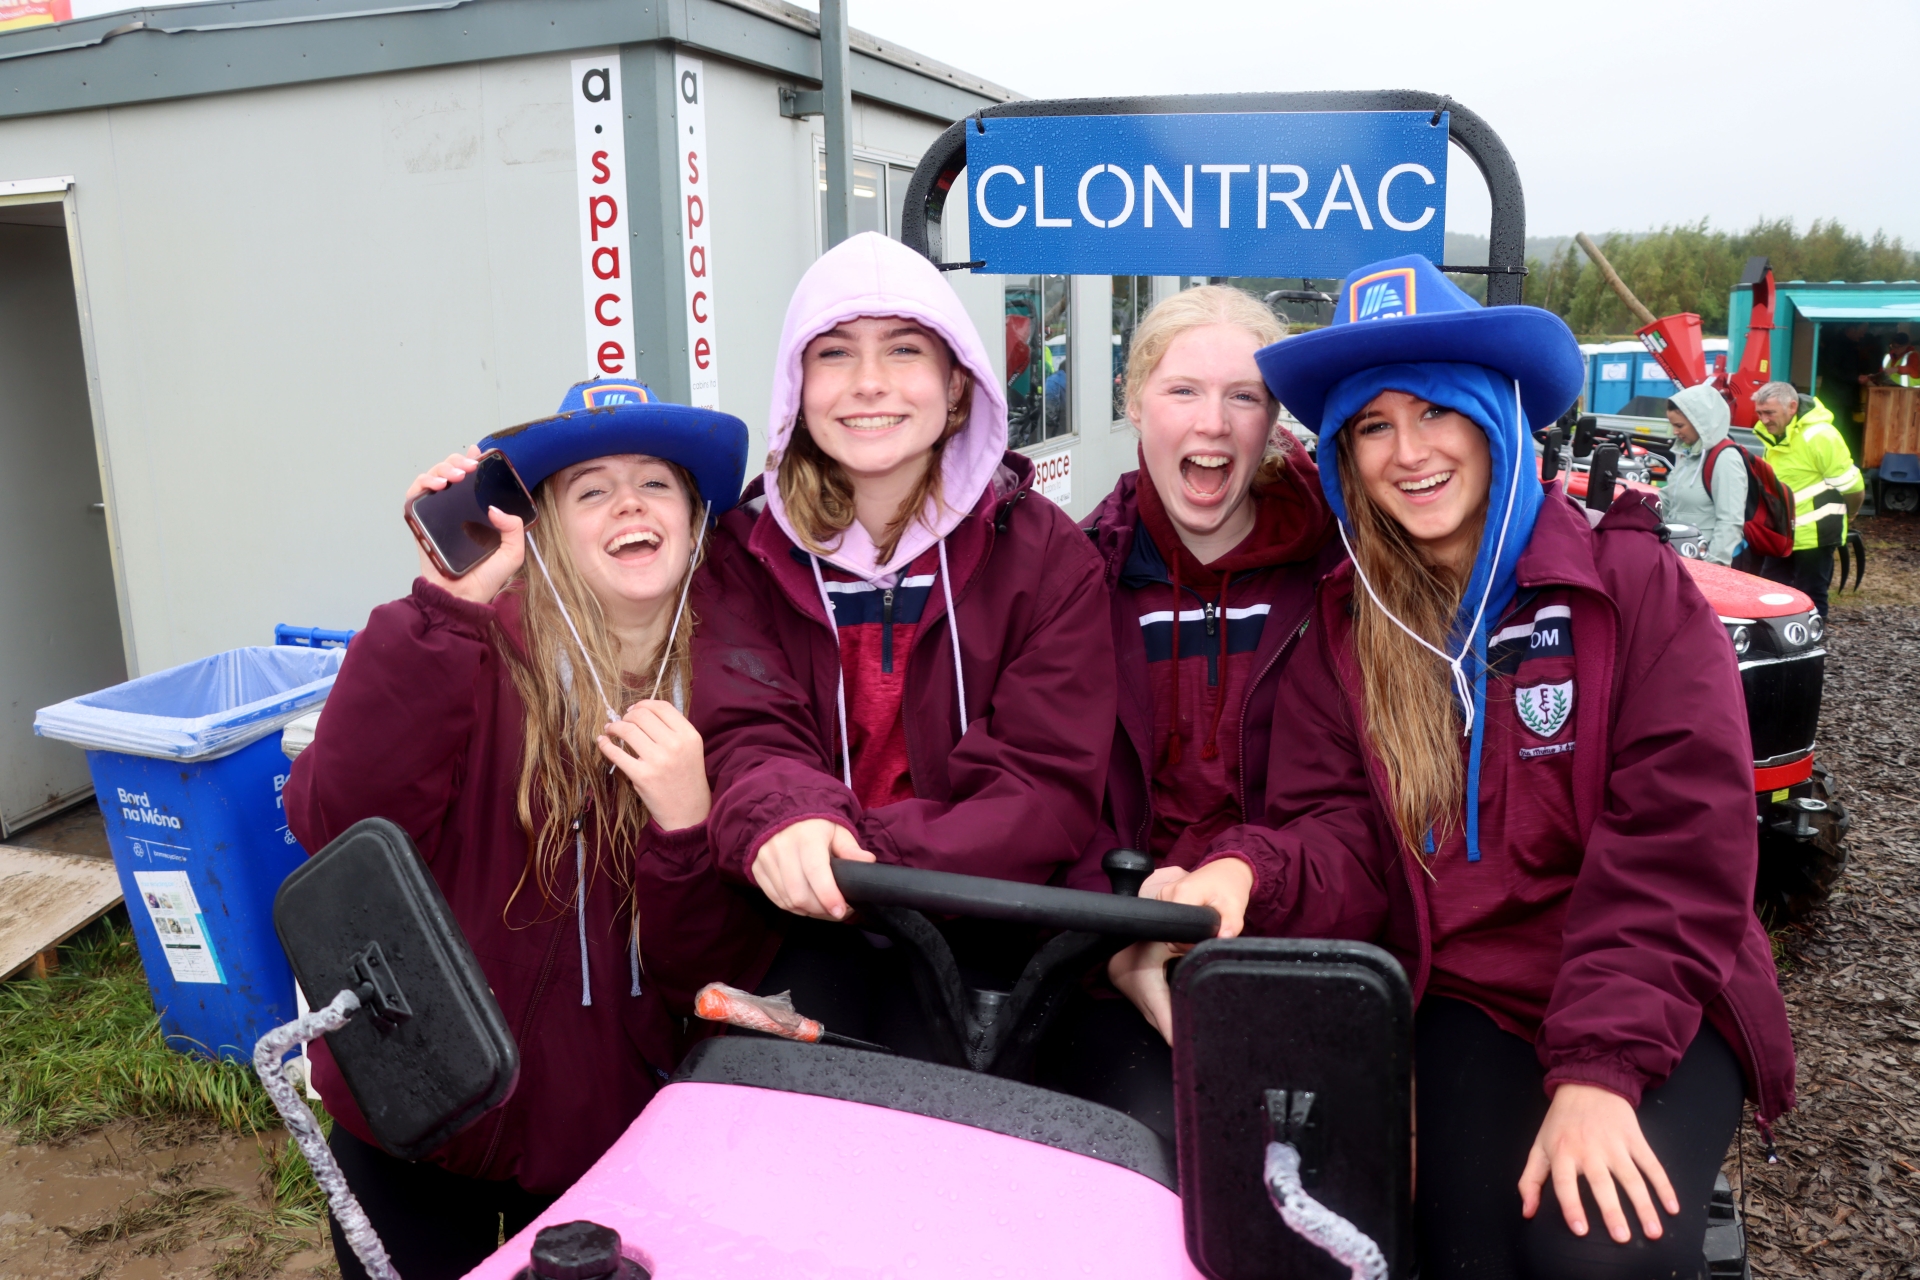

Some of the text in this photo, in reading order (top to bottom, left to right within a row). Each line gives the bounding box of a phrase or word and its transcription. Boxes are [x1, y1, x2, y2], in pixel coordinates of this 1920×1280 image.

[975, 163, 1437, 231] CLONTRAC
[117, 787, 150, 808] Bord
[122, 807, 181, 830] na Móna
